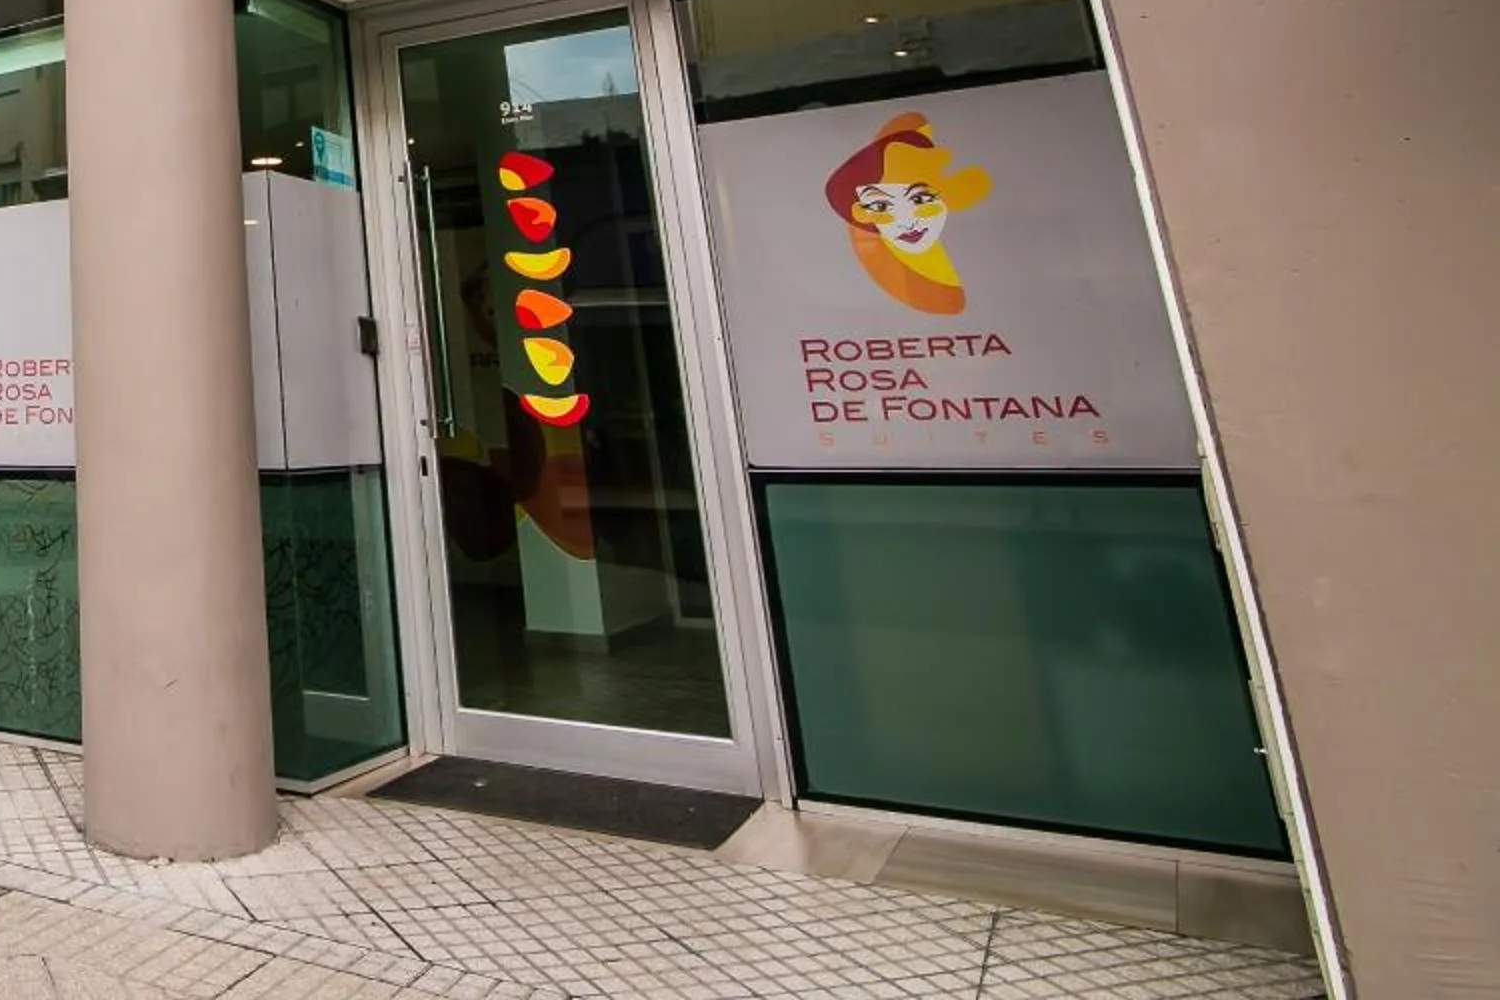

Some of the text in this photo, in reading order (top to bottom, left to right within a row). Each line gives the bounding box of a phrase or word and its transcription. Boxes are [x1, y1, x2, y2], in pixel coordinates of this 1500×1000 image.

[800, 333, 1012, 363] ROBERTA
[805, 368, 928, 393] ROSA
[25, 405, 74, 425] FON
[811, 395, 1101, 423] DE FONTANA
